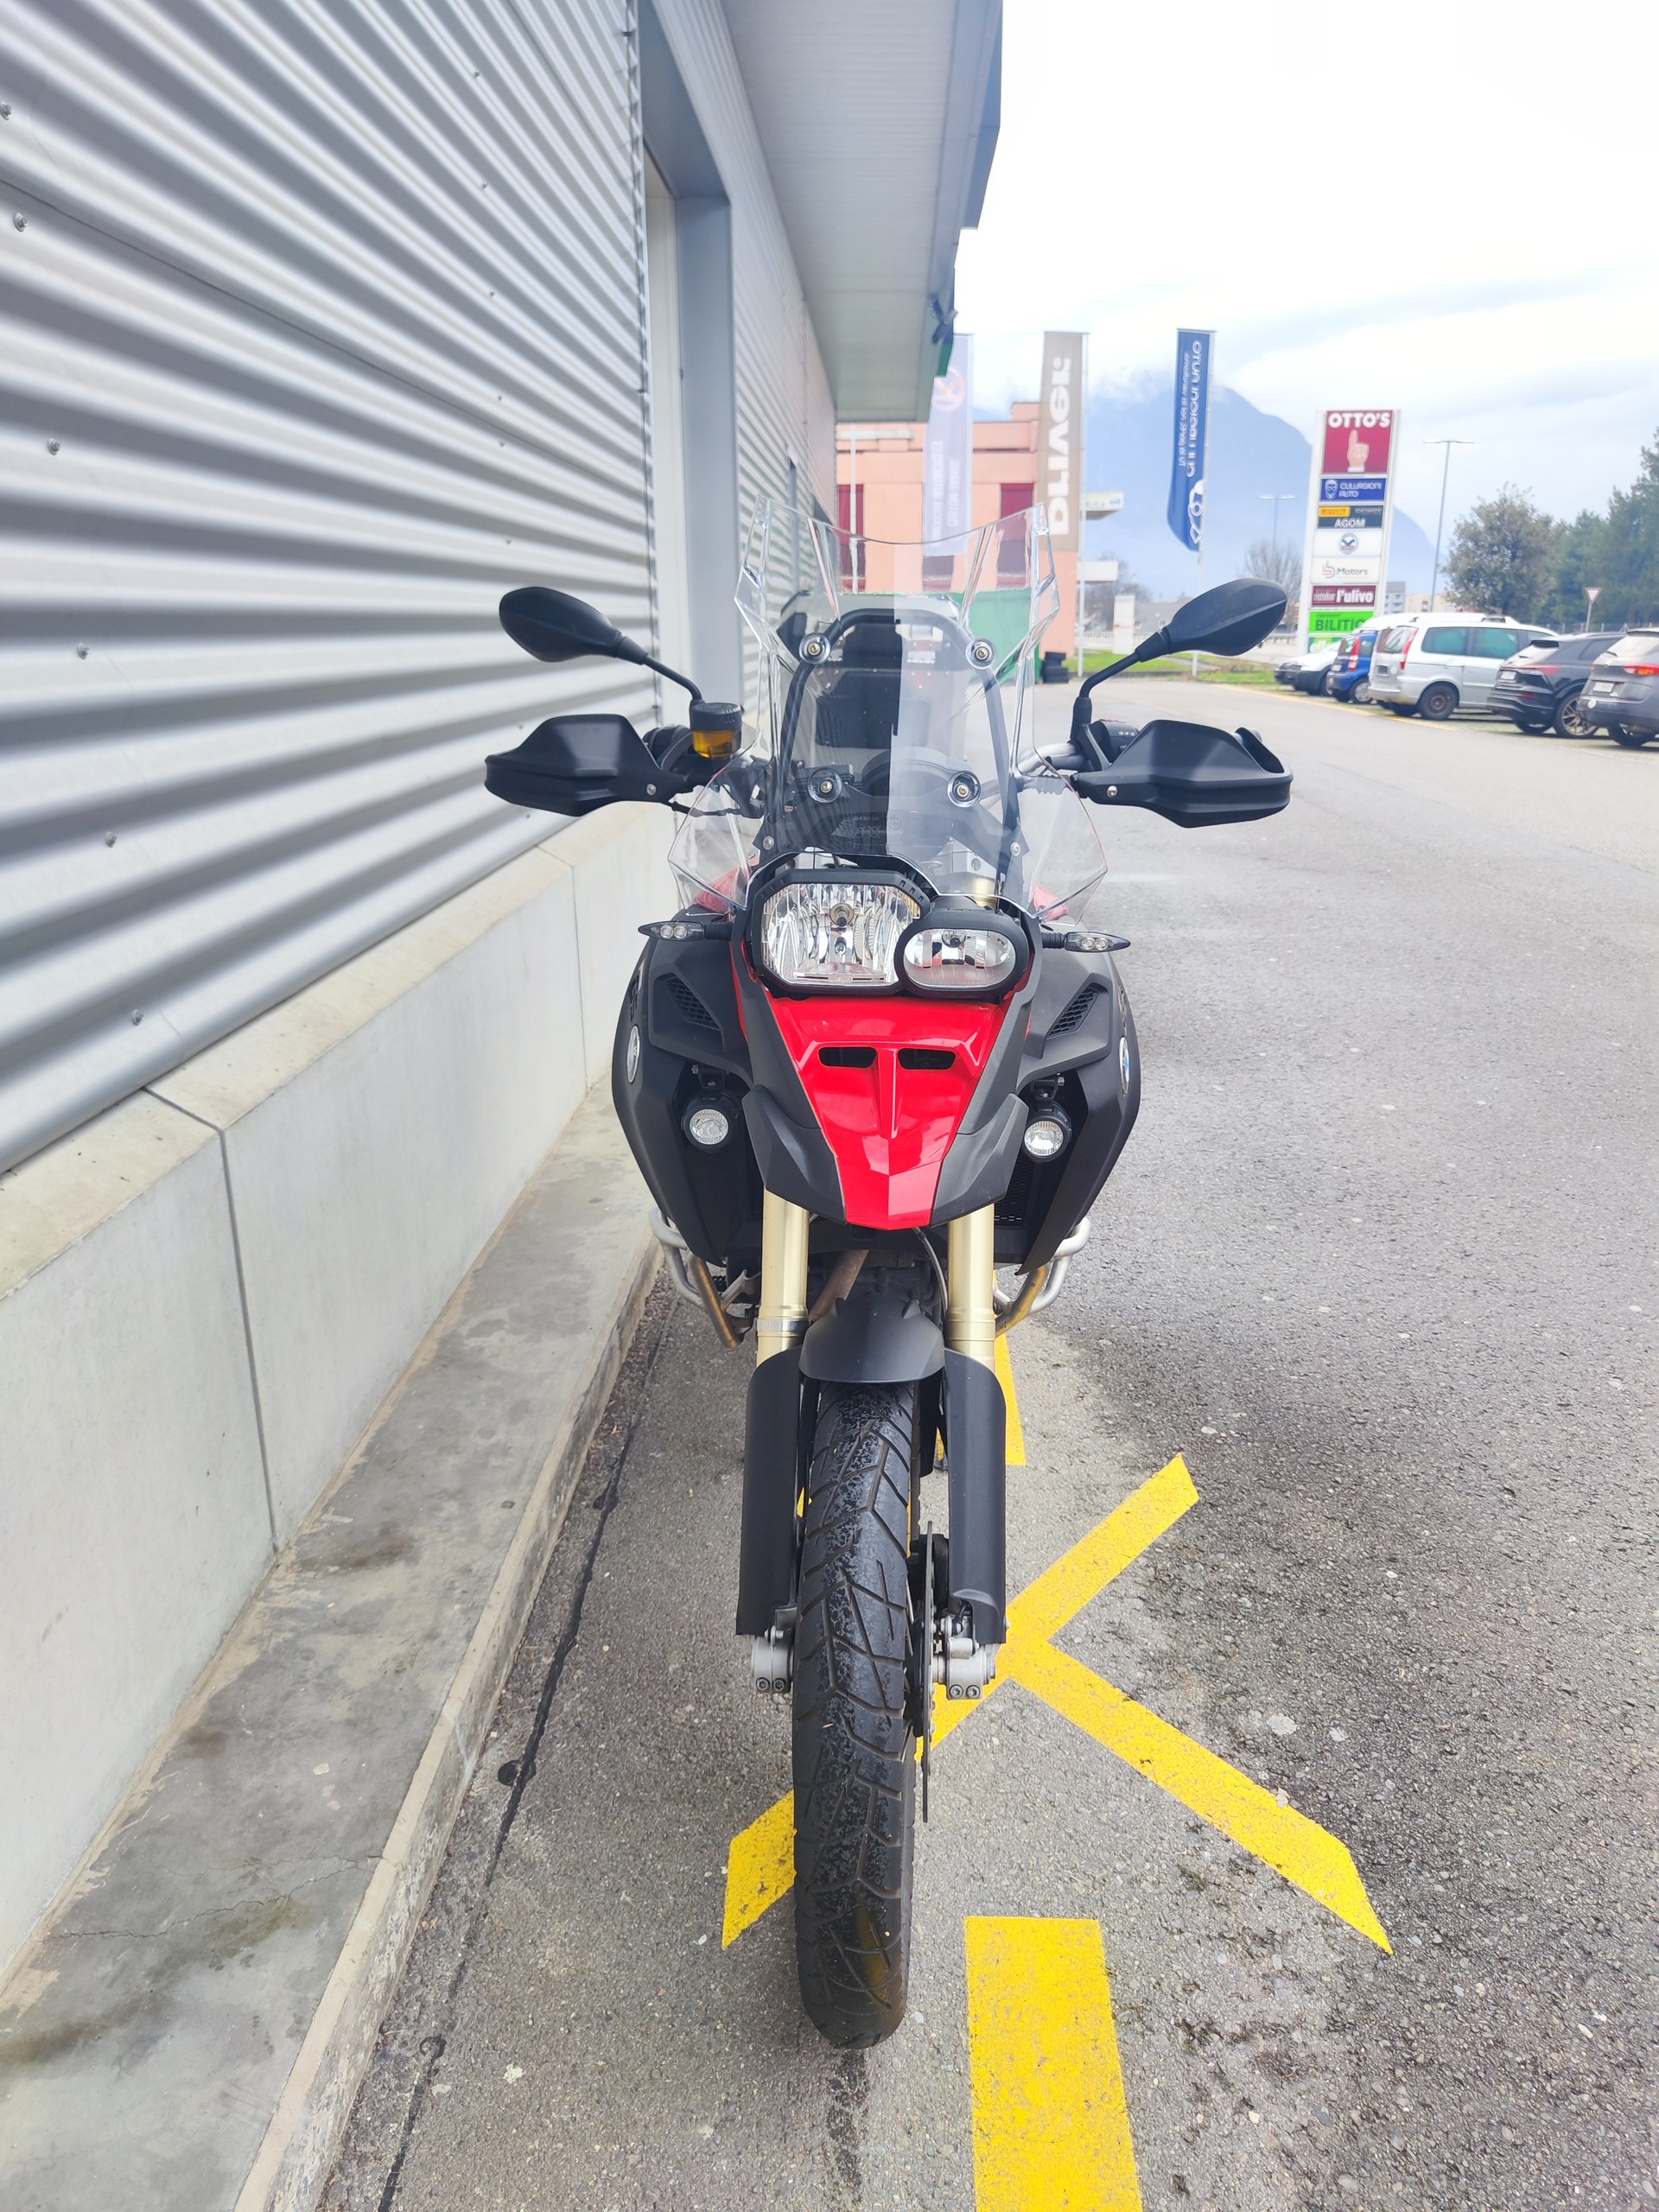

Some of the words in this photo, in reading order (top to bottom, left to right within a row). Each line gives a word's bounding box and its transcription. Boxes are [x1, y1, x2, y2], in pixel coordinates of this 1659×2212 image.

[1327, 412, 1390, 429] OTTO'S
[1334, 518, 1366, 528] AGOM
[1337, 567, 1369, 575] Motors
